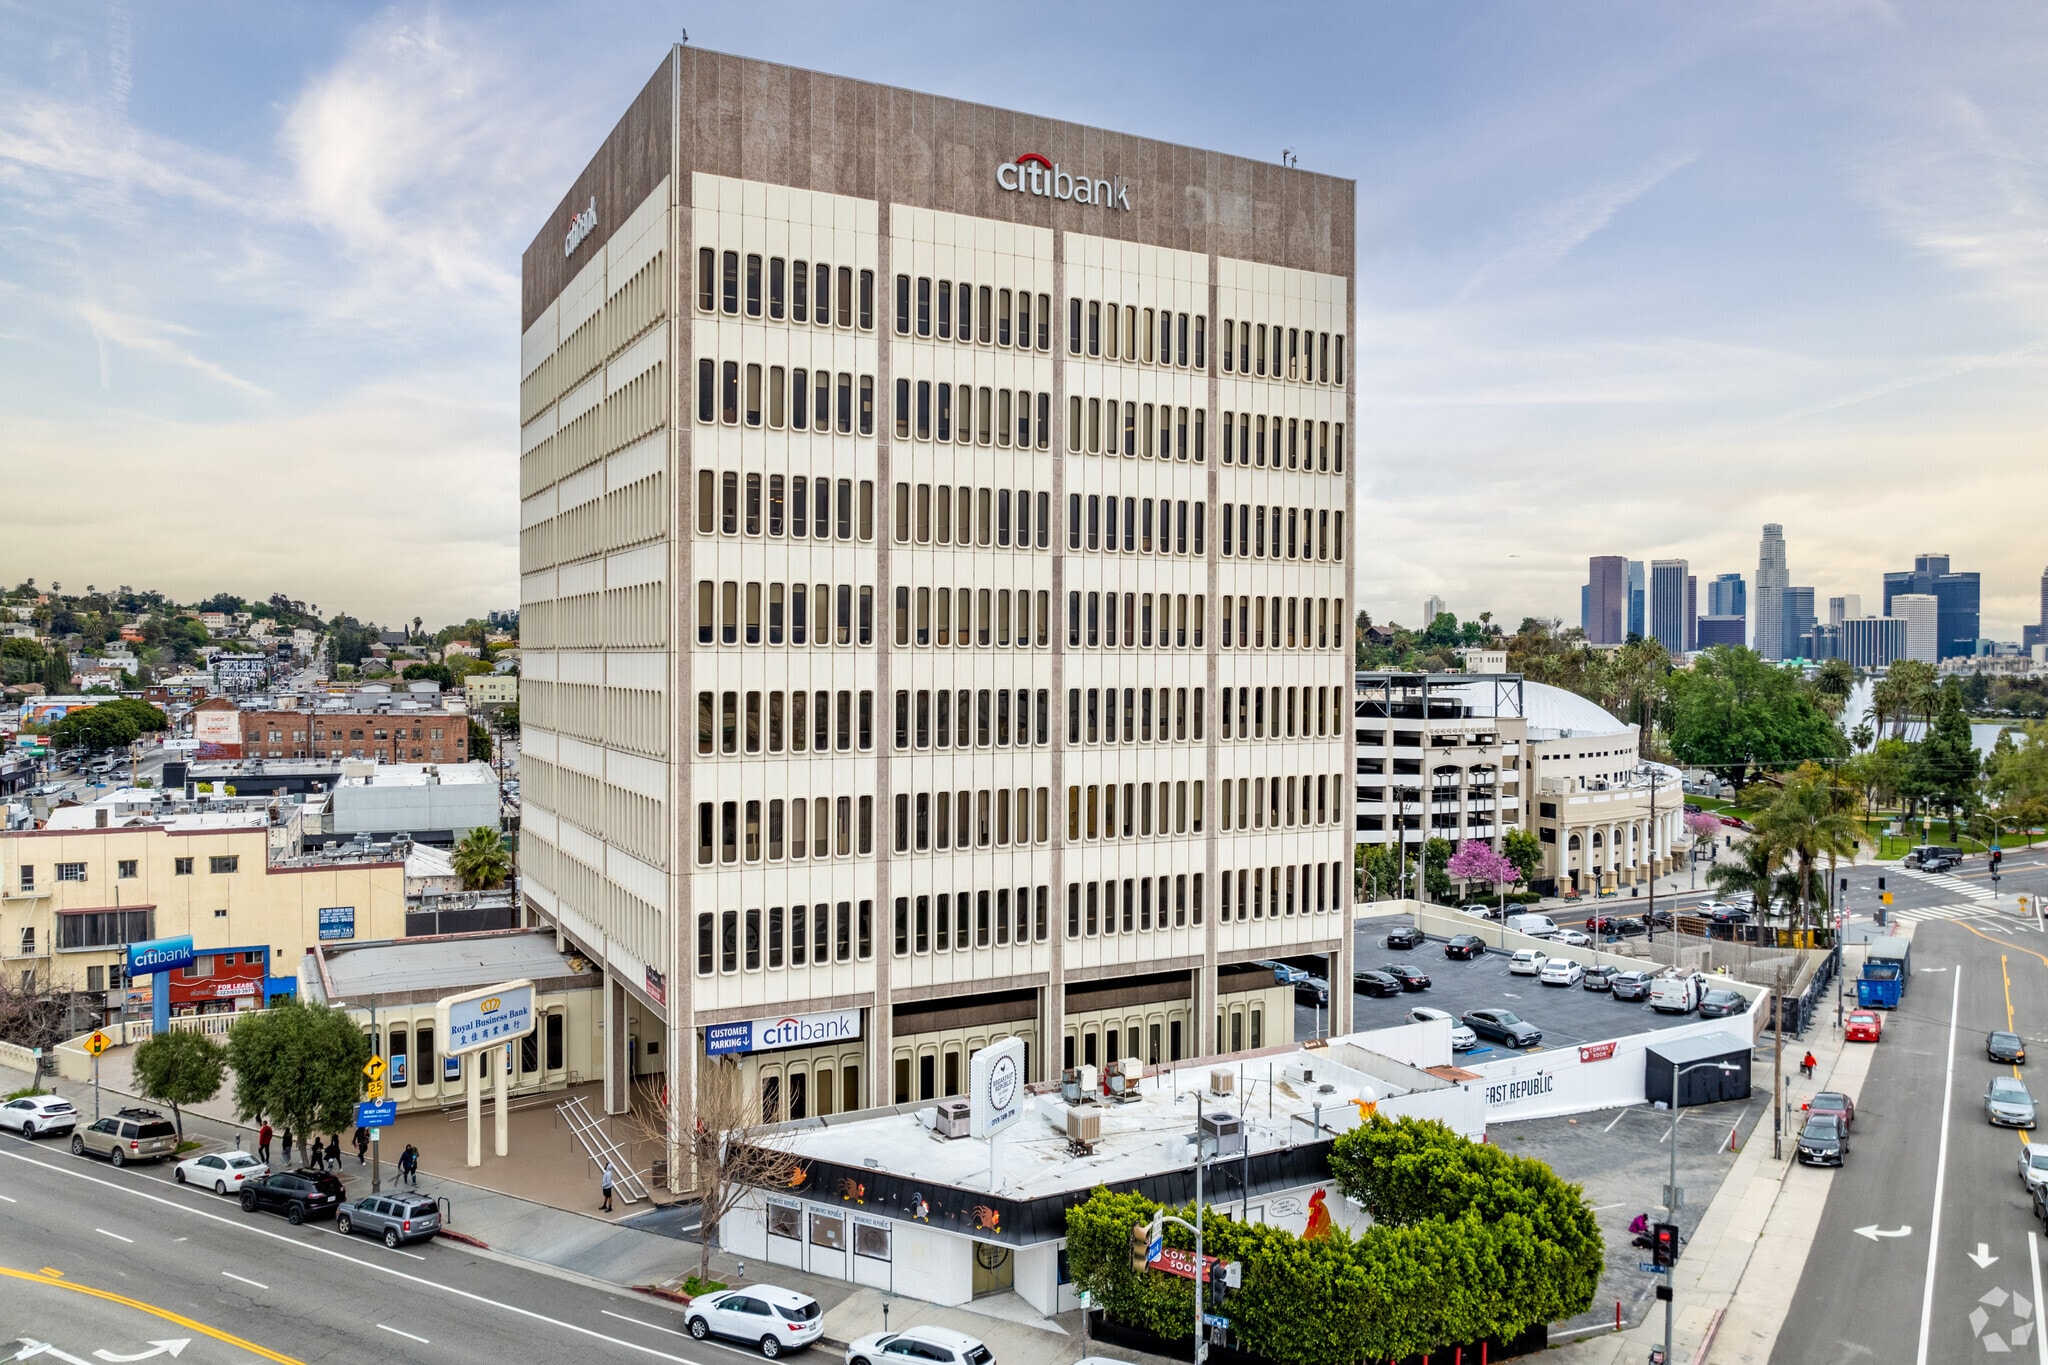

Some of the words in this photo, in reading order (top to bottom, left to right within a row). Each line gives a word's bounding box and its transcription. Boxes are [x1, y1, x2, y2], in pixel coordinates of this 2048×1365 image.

[996, 153, 1131, 211] citibank
[134, 946, 190, 967] citibank
[451, 1021, 473, 1035] Royal
[475, 1012, 508, 1029] Business
[509, 1006, 528, 1018] Bank
[710, 1026, 748, 1039] CUSTOMER
[763, 1015, 851, 1045] citibank
[710, 1037, 742, 1050] PARKING
[1589, 1045, 1609, 1054] COMING
[369, 1081, 383, 1093] 25
[992, 1071, 1014, 1088] BREAKFAST
[994, 1078, 1013, 1093] REPUBLIC
[1509, 1075, 1553, 1100] REPUBLIC
[783, 1199, 799, 1208] REPUBLIC
[809, 1205, 827, 1214] BREAKFAST
[827, 1209, 843, 1218] REPUBLIC
[854, 1215, 873, 1224] BREAKFAST
[872, 1219, 889, 1229] REPUBLIC
[1164, 1249, 1207, 1267] COMNG
